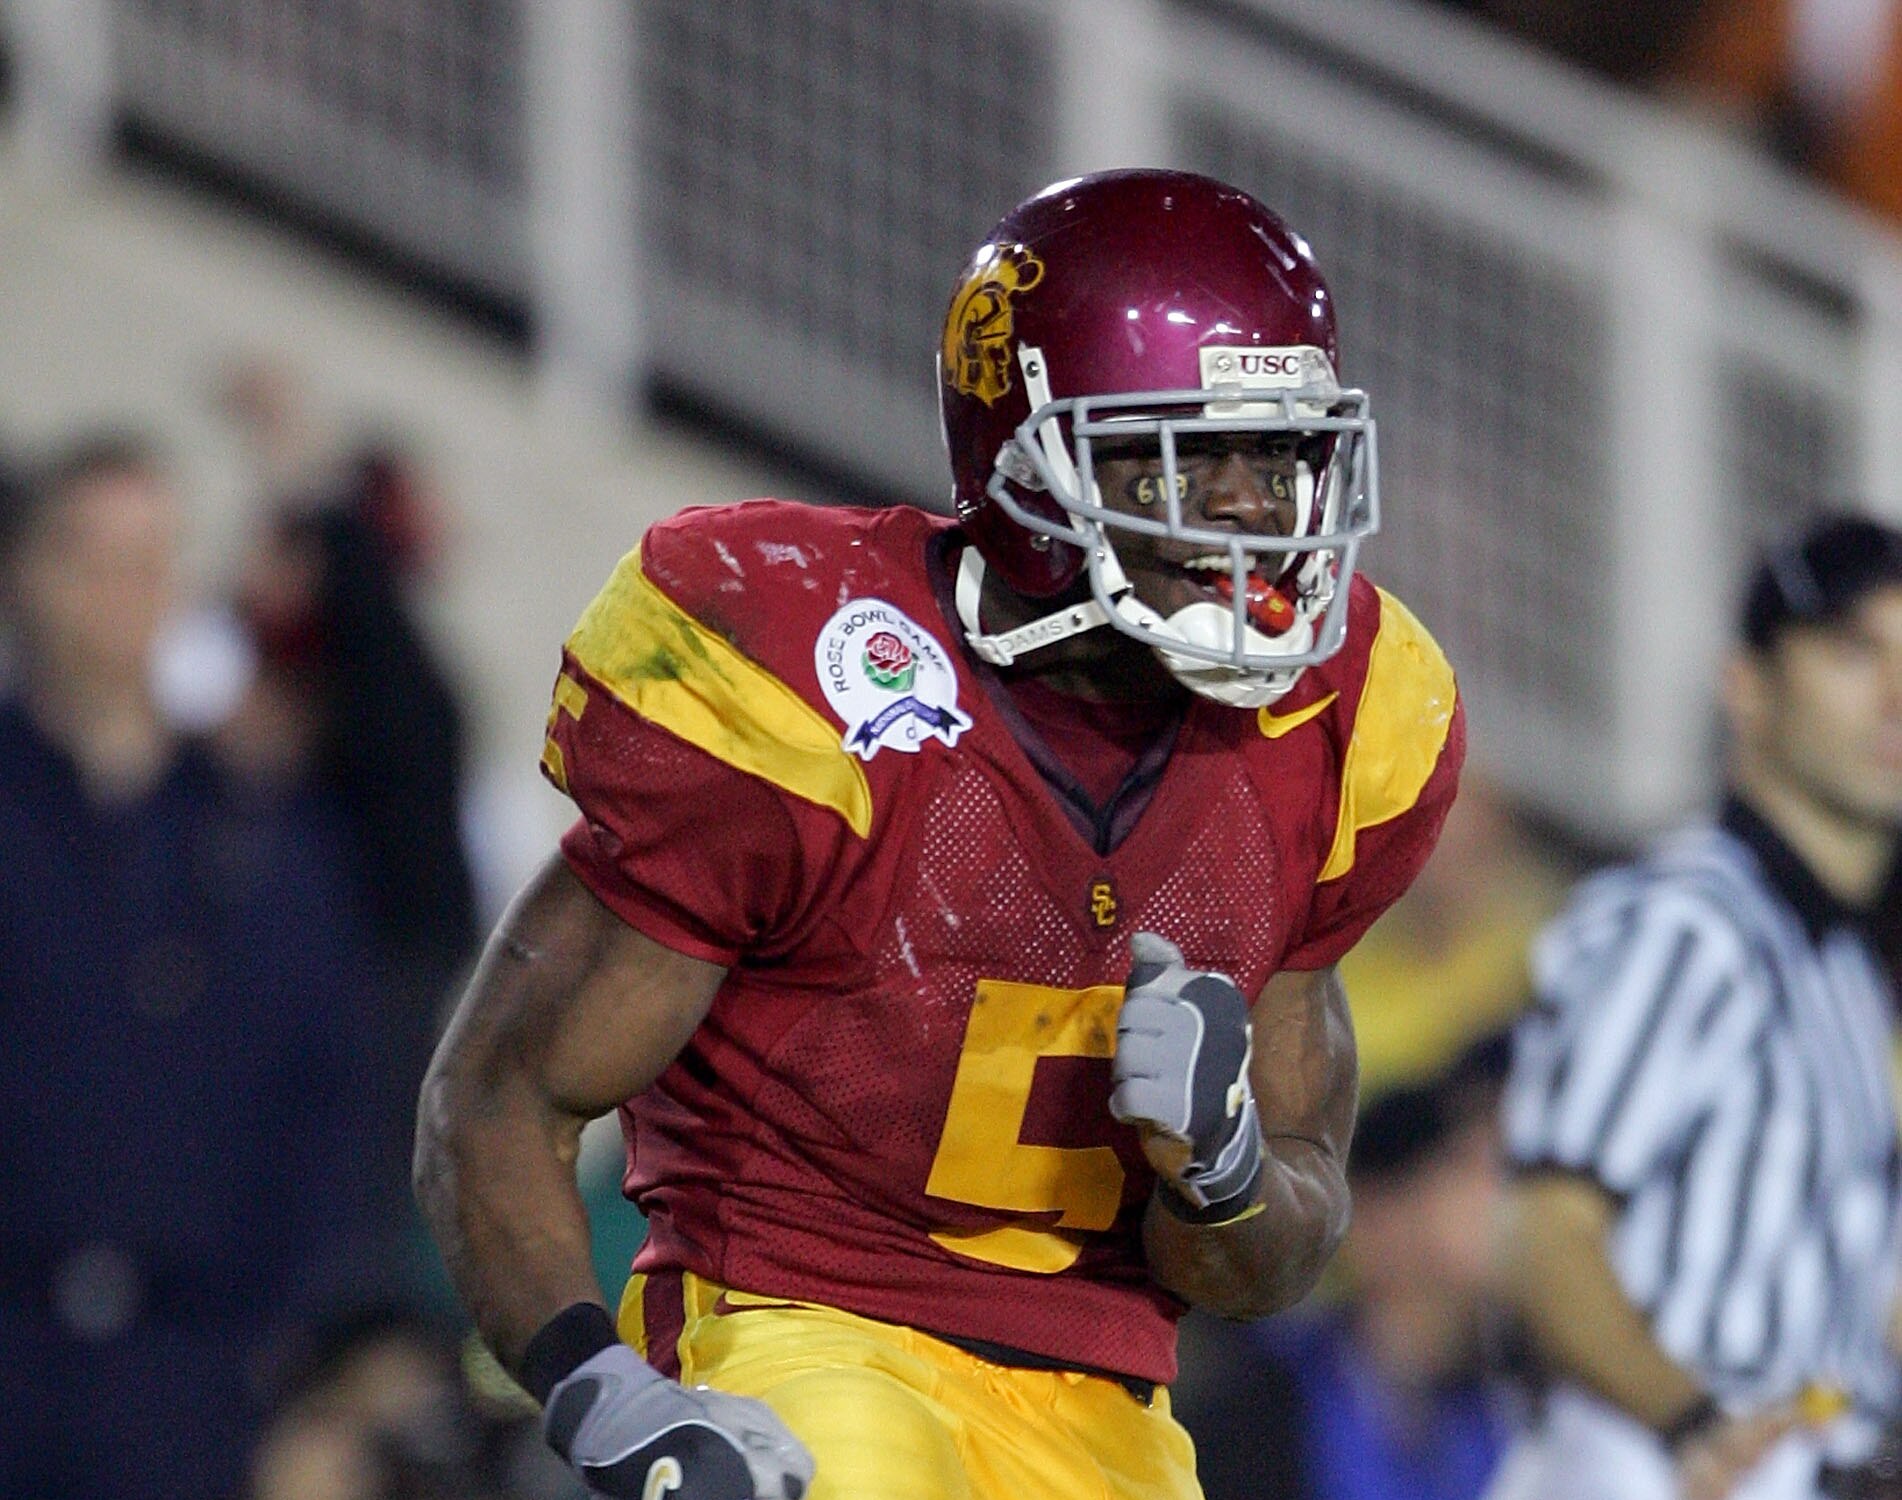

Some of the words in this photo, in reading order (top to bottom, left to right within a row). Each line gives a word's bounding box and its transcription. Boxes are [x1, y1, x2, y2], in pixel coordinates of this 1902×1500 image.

[1238, 354, 1300, 375] USC
[827, 637, 850, 693] ROSE
[843, 609, 895, 636] BOWL
